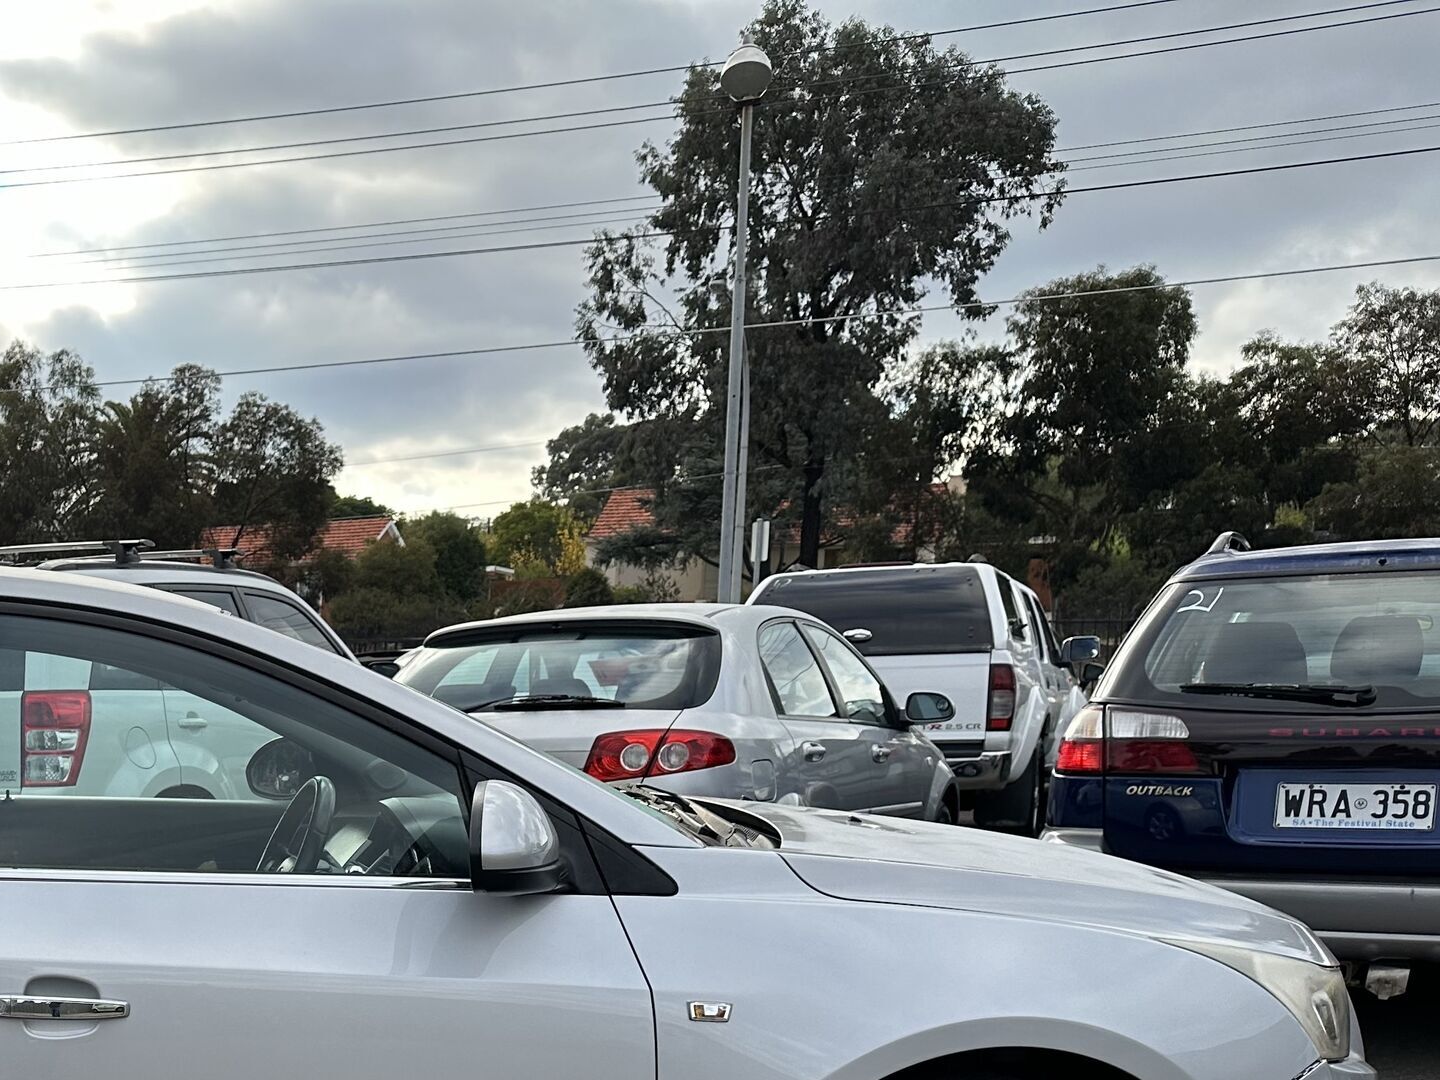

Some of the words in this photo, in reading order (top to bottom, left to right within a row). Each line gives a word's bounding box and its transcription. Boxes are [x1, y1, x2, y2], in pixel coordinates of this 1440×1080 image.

[1267, 727, 1440, 737] SUBAR
[1126, 785, 1193, 796] OUTBACK
[1284, 789, 1352, 818] WRA
[1371, 790, 1431, 819] 358
[1338, 819, 1381, 828] Festival
[1386, 820, 1415, 828] State
